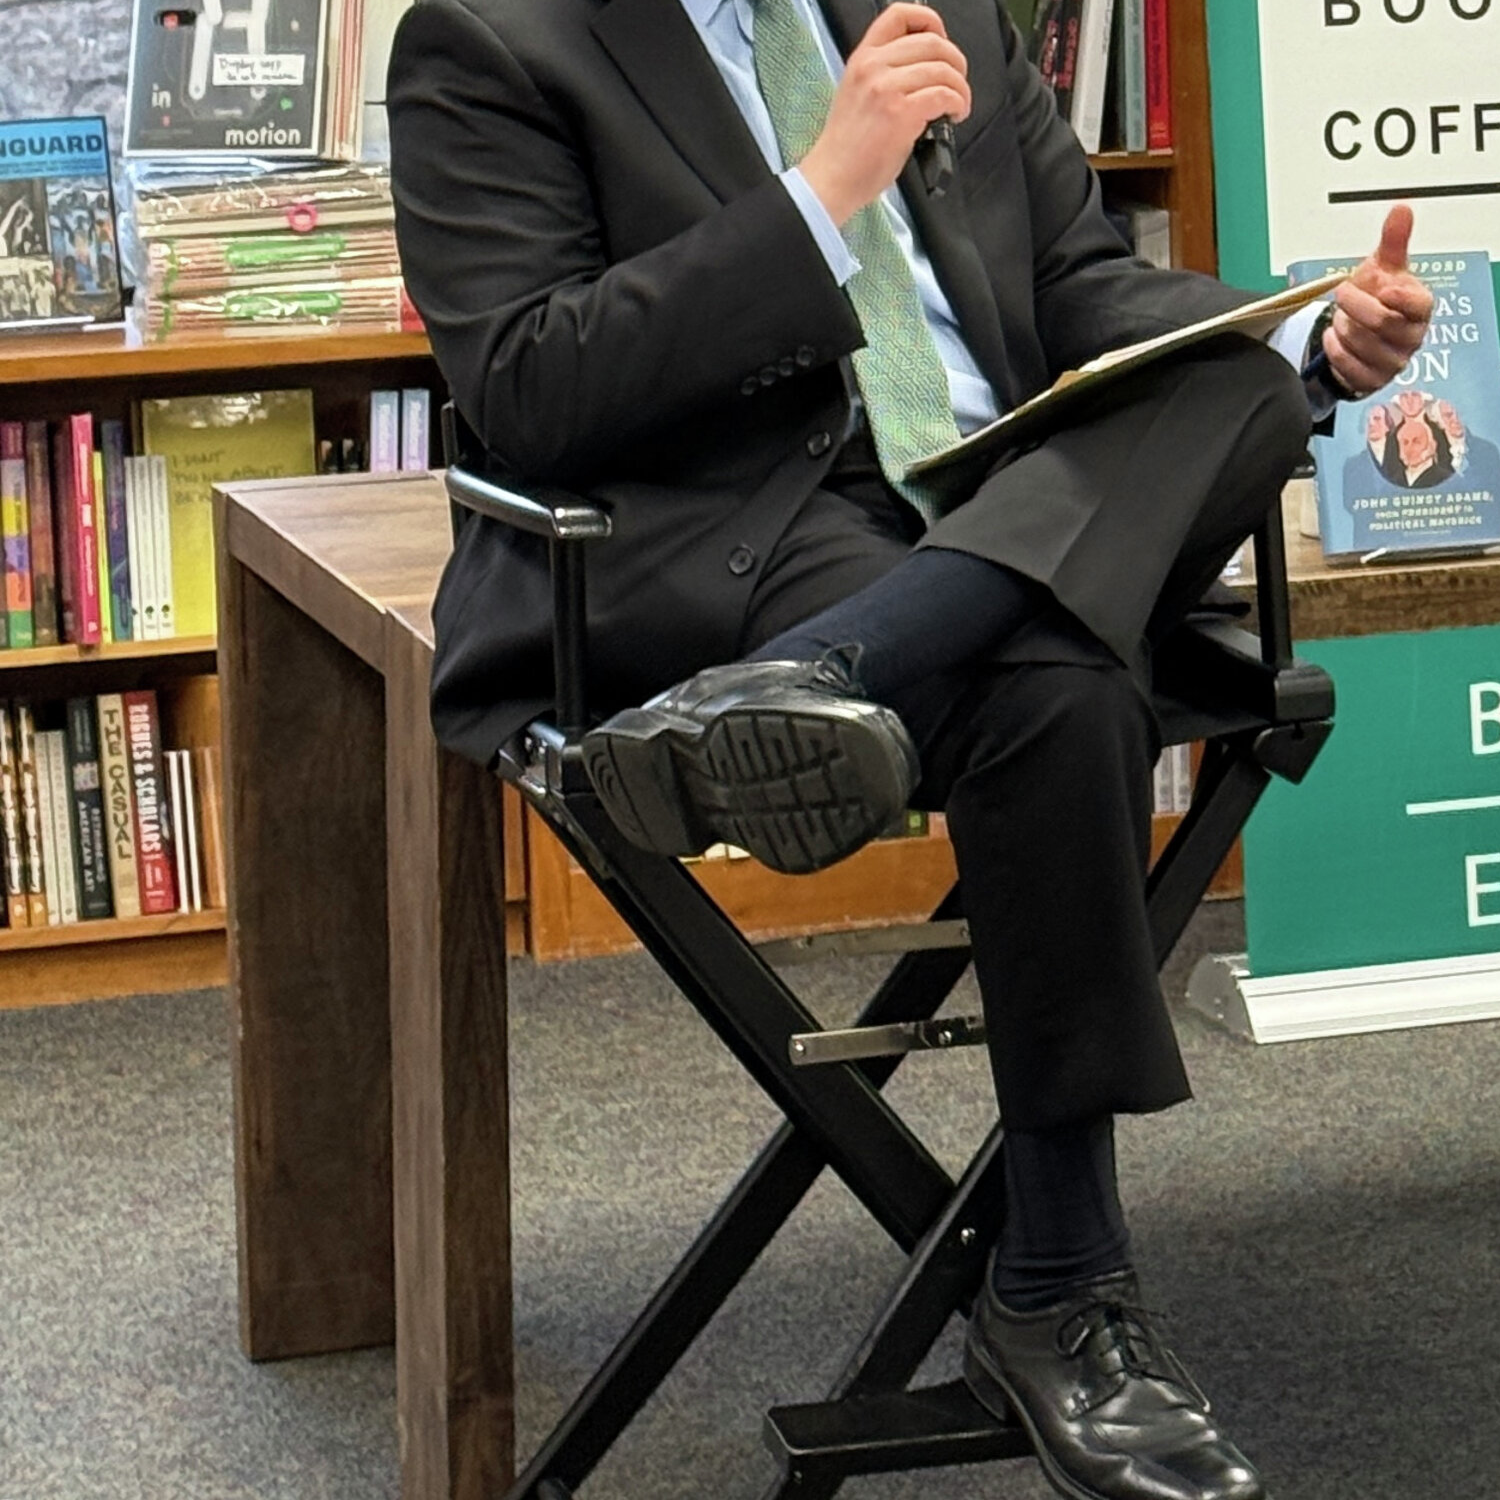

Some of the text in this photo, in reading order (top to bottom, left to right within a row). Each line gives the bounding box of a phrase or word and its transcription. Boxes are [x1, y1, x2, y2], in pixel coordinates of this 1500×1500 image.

[151, 83, 172, 109] in
[224, 122, 301, 147] motion
[1395, 348, 1452, 388] ON
[1353, 497, 1388, 510] JOHN
[1369, 518, 1427, 532] POLITICAL
[102, 707, 133, 861] THE CASUAL
[128, 703, 162, 853] ROGUES & SCHOLARS
[78, 800, 95, 893] AMERICAN ART
